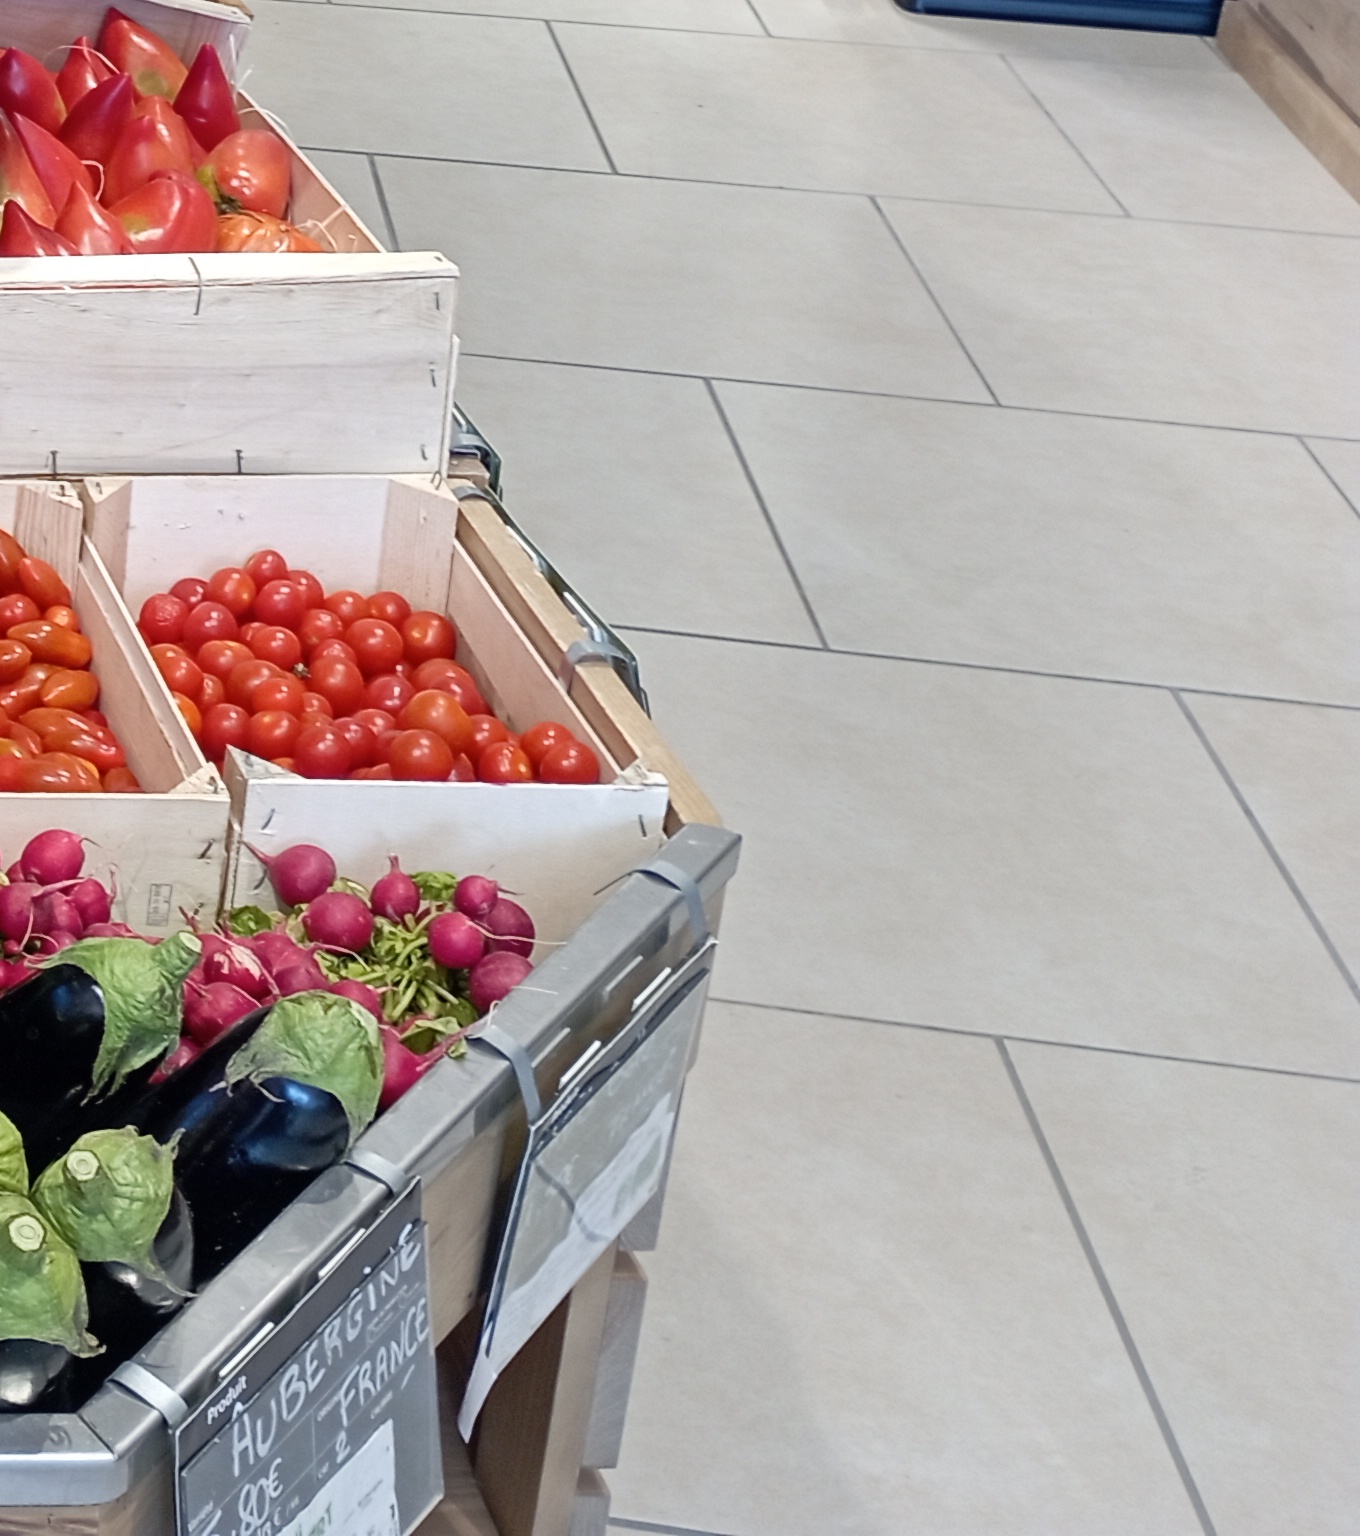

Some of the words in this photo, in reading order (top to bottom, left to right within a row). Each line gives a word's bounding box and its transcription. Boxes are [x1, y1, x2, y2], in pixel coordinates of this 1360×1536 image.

[207, 1375, 247, 1425] Produit
[232, 1223, 422, 1477] AUBERGINE
[340, 1298, 429, 1427] FRANCE
